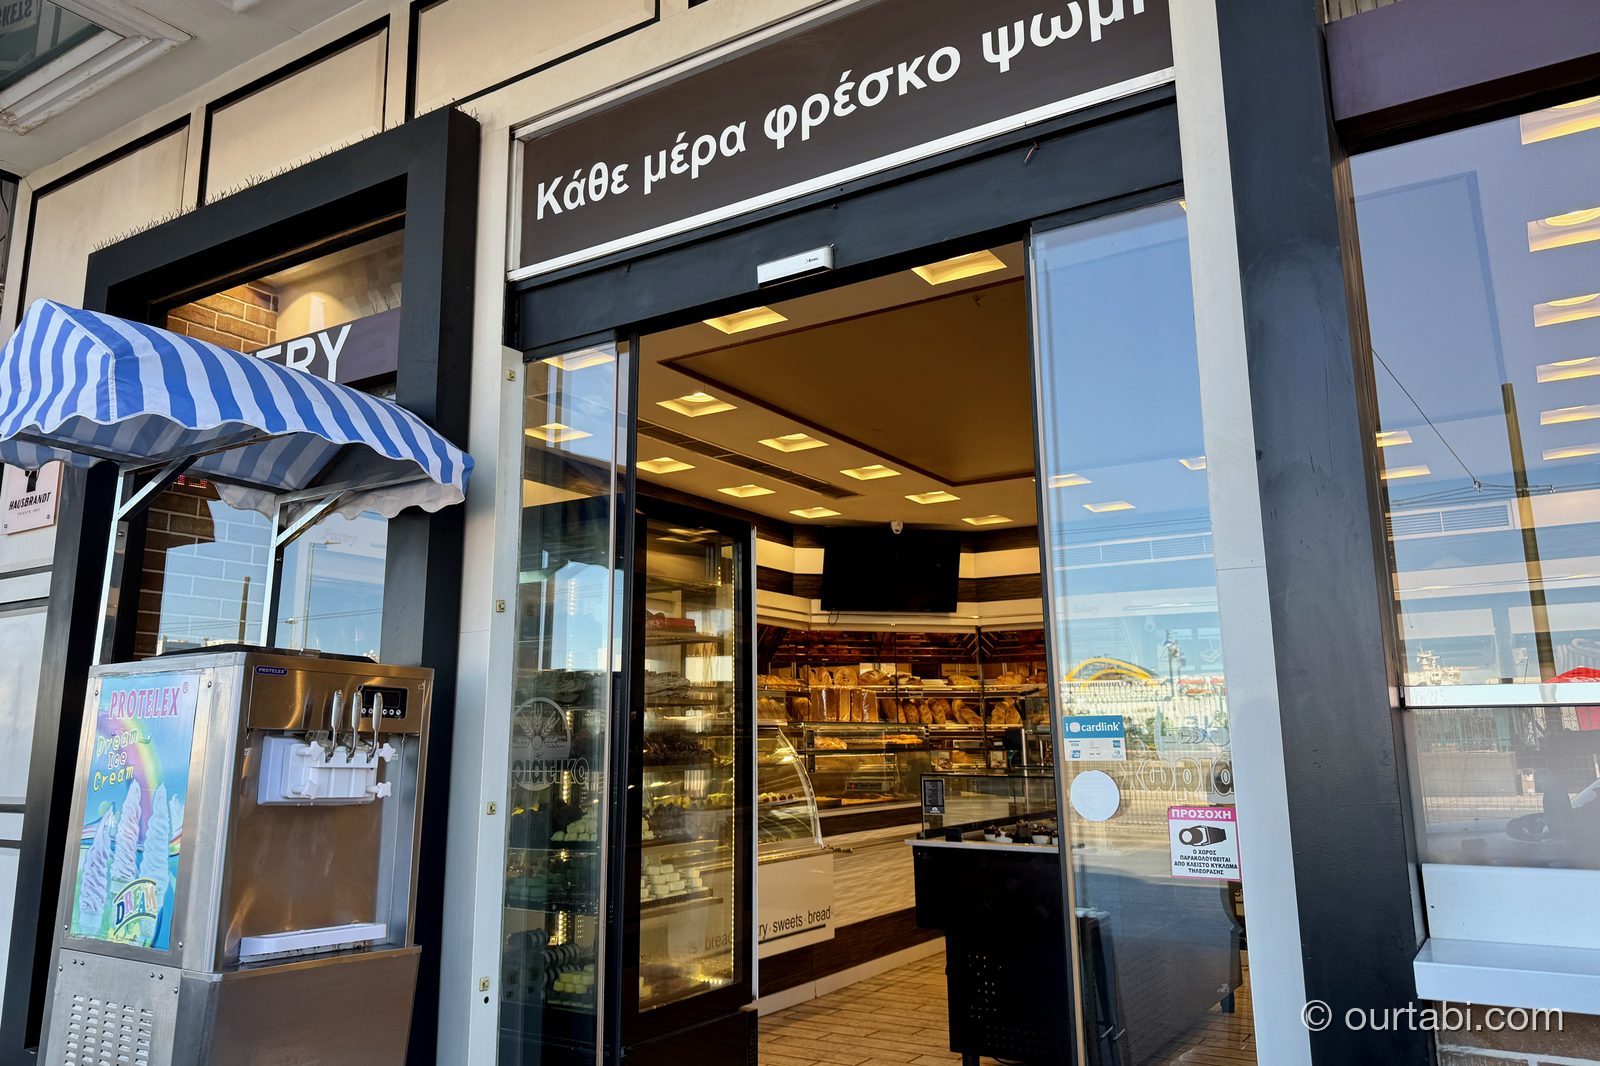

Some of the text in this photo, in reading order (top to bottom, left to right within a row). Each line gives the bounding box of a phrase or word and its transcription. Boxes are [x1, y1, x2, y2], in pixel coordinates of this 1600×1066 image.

[537, 162, 629, 220] Κάθε
[644, 119, 746, 195] μέρα
[763, 46, 961, 150] φρέσκο
[256, 324, 352, 383] RY
[8, 492, 51, 510] HAUSBRANDT
[258, 667, 285, 675] PROTELEX
[109, 688, 181, 719] PROTELEX
[1081, 721, 1119, 732] cardlink
[96, 728, 139, 758] Dream
[108, 751, 127, 770] Ice
[93, 766, 134, 792] Cream
[1171, 809, 1231, 819] ΠΡΟΣΟΧΗ
[115, 881, 157, 926] DREAM
[758, 905, 831, 939] ry sweets bread
